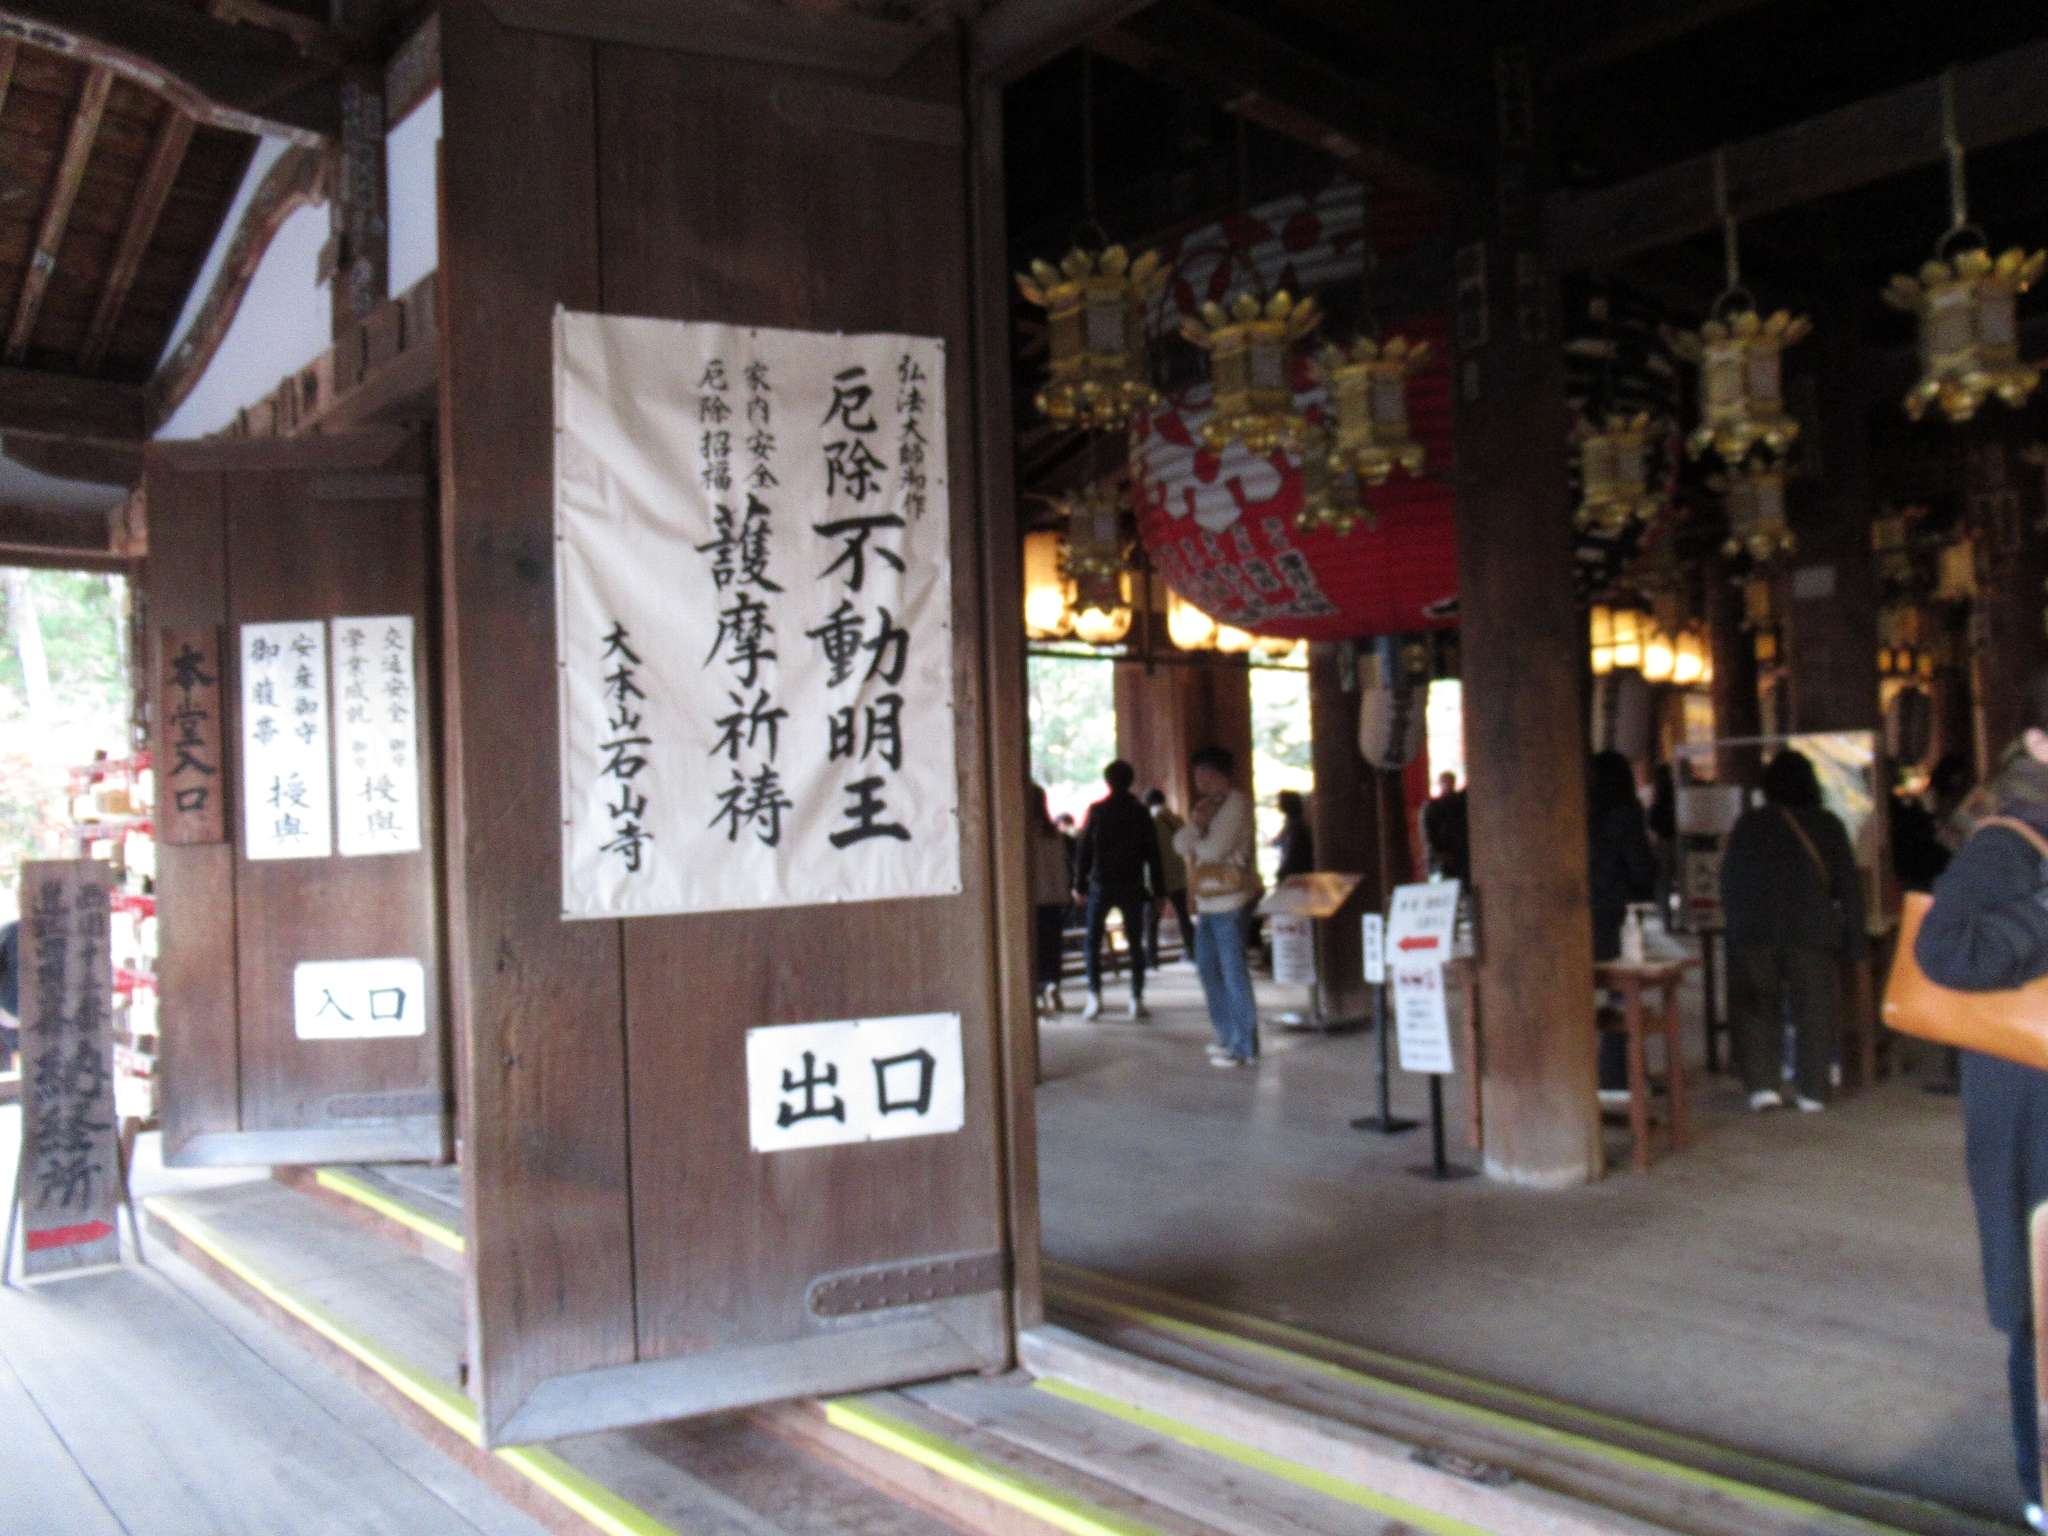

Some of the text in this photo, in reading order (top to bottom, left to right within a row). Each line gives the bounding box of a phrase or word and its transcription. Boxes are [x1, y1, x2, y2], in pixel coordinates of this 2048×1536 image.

[698, 358, 733, 491] 厄除招福
[744, 361, 779, 490] 家内安全
[805, 366, 911, 849] 厄除不動明王
[599, 621, 654, 873] 大本山石山寺
[316, 987, 407, 1021] 入口
[776, 1048, 936, 1128] 出口
